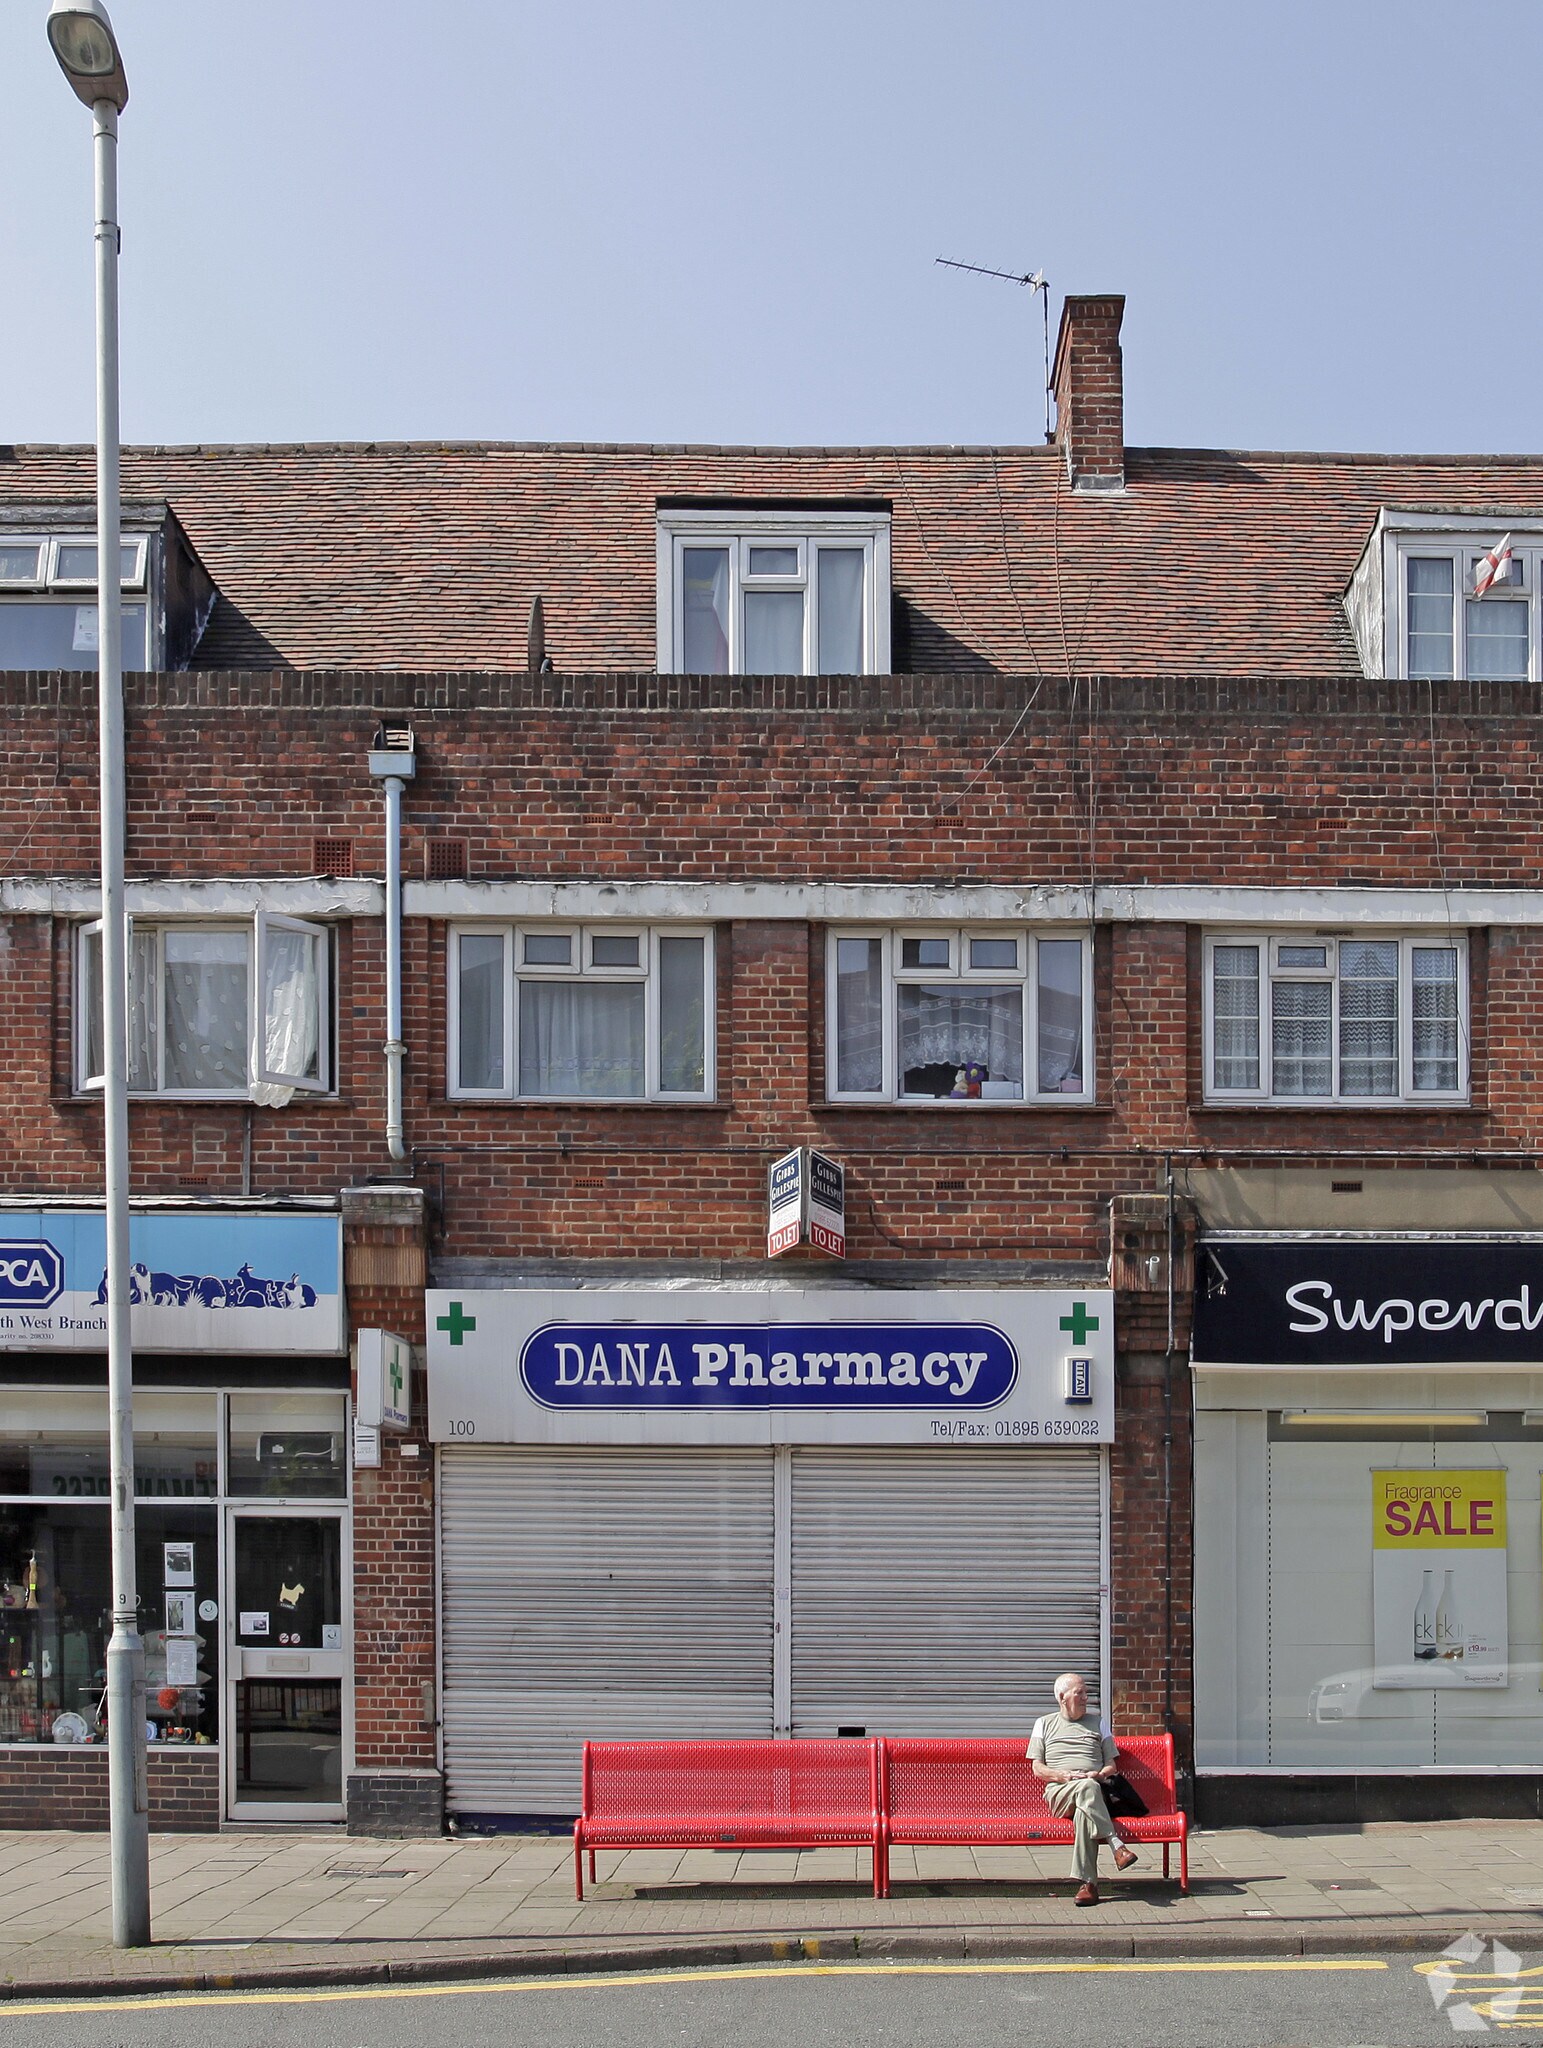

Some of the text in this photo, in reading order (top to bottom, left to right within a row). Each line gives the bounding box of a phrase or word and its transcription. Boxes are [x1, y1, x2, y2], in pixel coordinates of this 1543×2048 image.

[776, 1163, 795, 1183] GIBBS
[817, 1163, 837, 1185] GIBBS
[771, 1176, 800, 1200] GILLESPIE
[771, 1224, 797, 1252] TO LET
[813, 1225, 842, 1253] TO LET
[20, 1315, 53, 1329] West
[59, 1315, 107, 1330] Branch
[554, 1343, 987, 1396] DANA Pharmacy
[1076, 1362, 1086, 1394] TITAN
[449, 1420, 475, 1436] 100
[930, 1420, 1099, 1438] Tel/Fax: 01895 639022
[1385, 1482, 1462, 1503] Fragrance
[1385, 1500, 1494, 1536] SALE
[119, 1593, 126, 1604] 9
